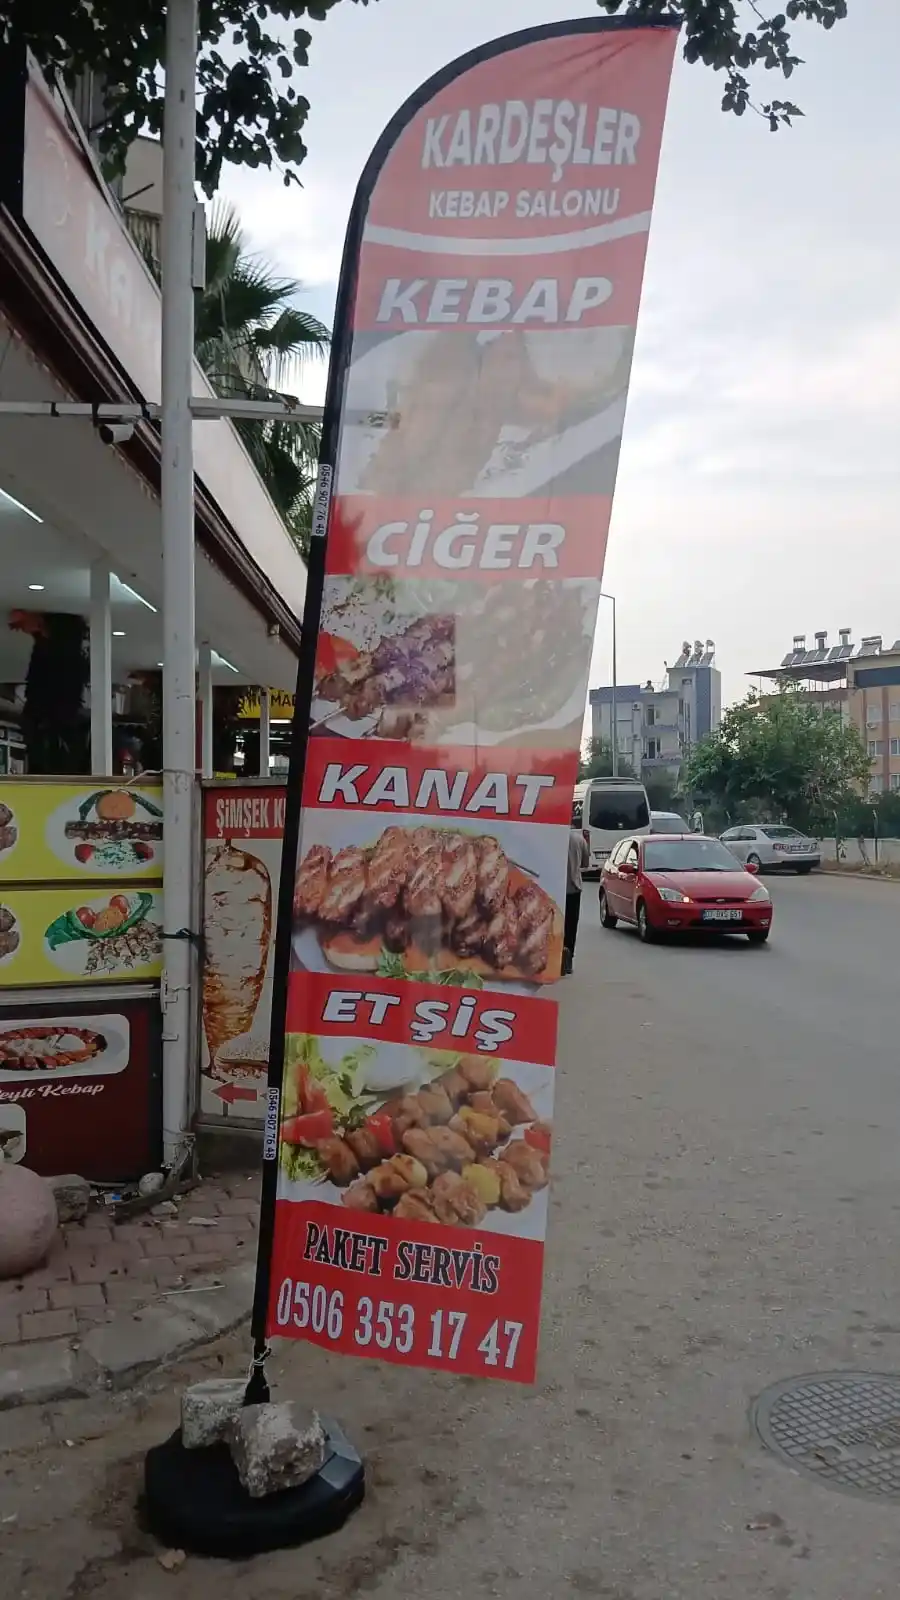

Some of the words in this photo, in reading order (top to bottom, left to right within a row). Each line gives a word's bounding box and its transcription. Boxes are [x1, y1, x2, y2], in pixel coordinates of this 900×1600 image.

[421, 97, 642, 184] KARDEŞLER
[428, 189, 510, 220] KEBAP
[515, 187, 621, 218] SALONU
[375, 276, 613, 324] KEBAP
[316, 510, 326, 521] 76
[318, 491, 329, 507] 907
[365, 508, 567, 570] CİĞER
[318, 763, 555, 817] KANAT
[321, 989, 401, 1025] ET
[409, 995, 517, 1051] ŞİŞ
[37, 1082, 105, 1098] Kebap
[268, 1088, 278, 1111] 0546
[267, 1114, 277, 1130] 907
[265, 1147, 275, 1158] 48
[266, 1133, 276, 1145] 76
[303, 1221, 388, 1277] PAKET
[393, 1241, 501, 1295] SERVİS
[276, 1277, 344, 1340] 0506
[354, 1296, 415, 1354] 353
[427, 1309, 468, 1360] 17
[477, 1316, 523, 1369] 47
